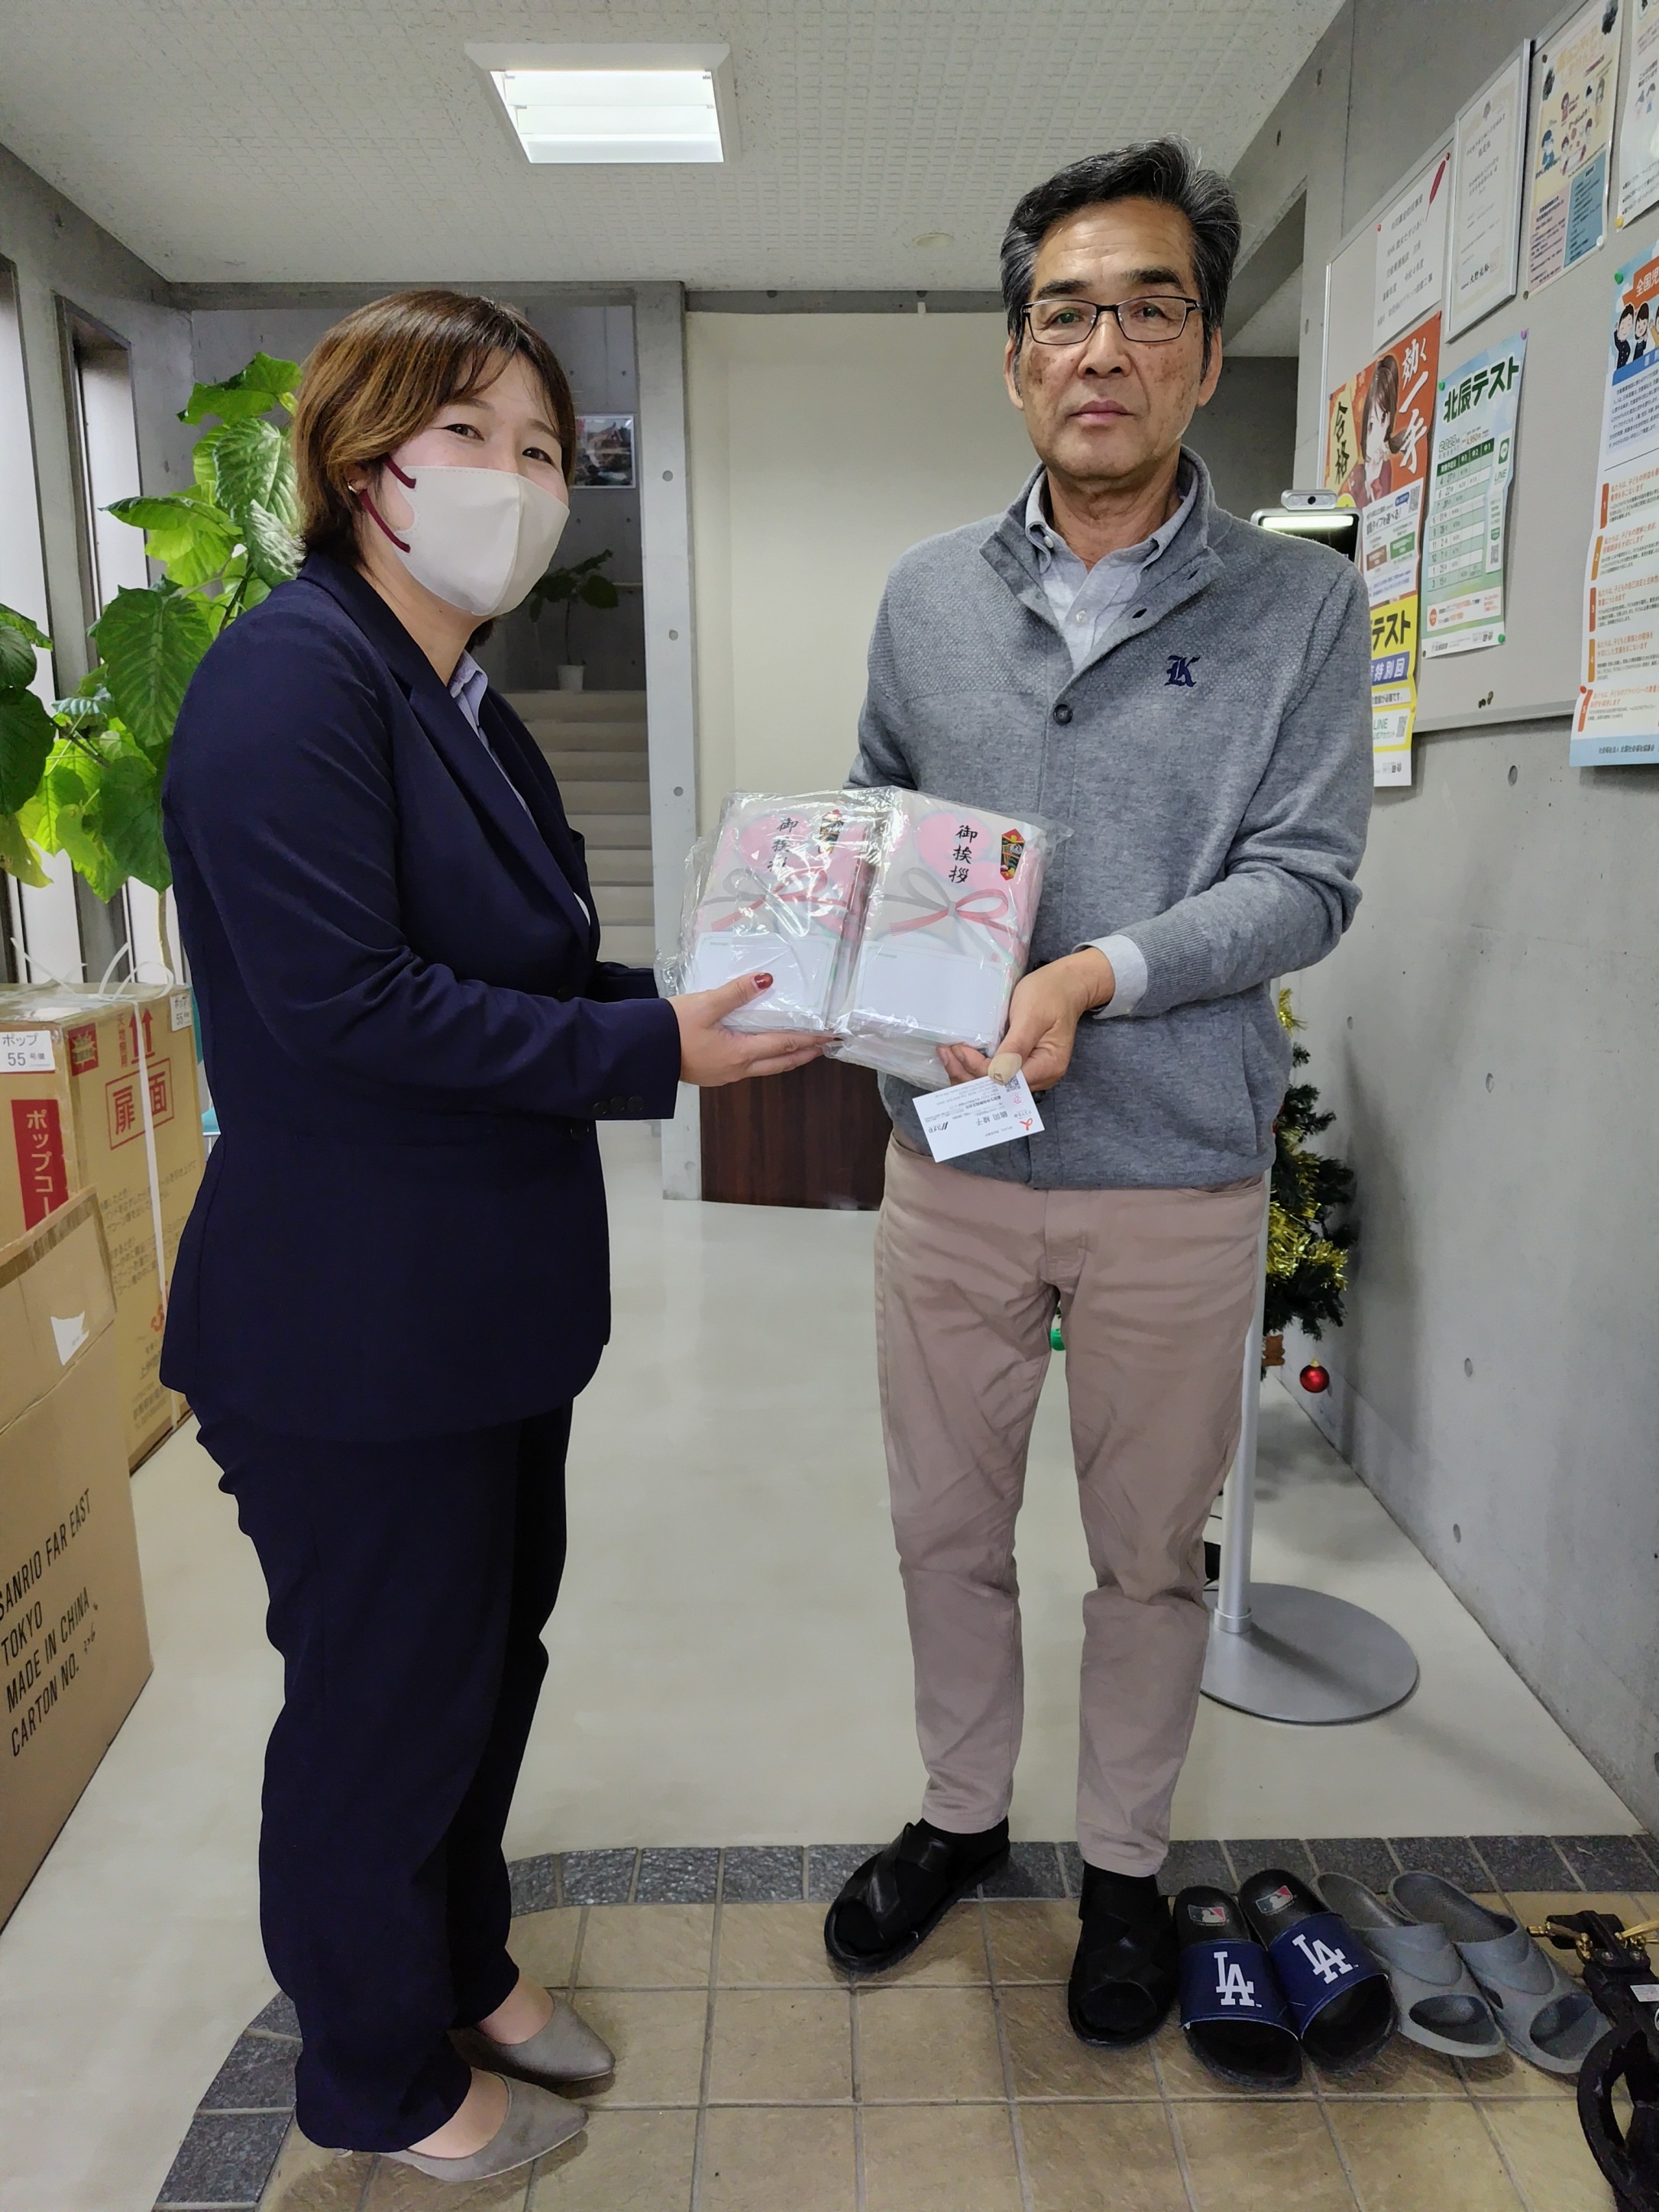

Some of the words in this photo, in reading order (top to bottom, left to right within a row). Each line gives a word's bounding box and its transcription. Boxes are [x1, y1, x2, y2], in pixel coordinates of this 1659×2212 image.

[1444, 356, 1519, 422] 北辰テスト
[1334, 401, 1350, 486] 合格
[1495, 468, 1507, 481] LINE
[1164, 655, 1201, 687] K
[949, 824, 978, 884] 御挨拶
[2, 1033, 38, 1047] ポップ
[8, 1053, 26, 1066] 55
[0, 1551, 42, 1622] SANRIO
[46, 1522, 67, 1567] FAR
[70, 1488, 90, 1538] EAST
[1, 1601, 43, 1667] TOKYO
[6, 1649, 41, 1713] MADE
[45, 1628, 57, 1664] IN
[60, 1586, 89, 1643] CHINA
[11, 1676, 58, 1757] CARTON
[60, 1653, 79, 1691] NO.
[1214, 1951, 1255, 2007] LA
[1292, 1934, 1353, 1984] LA
